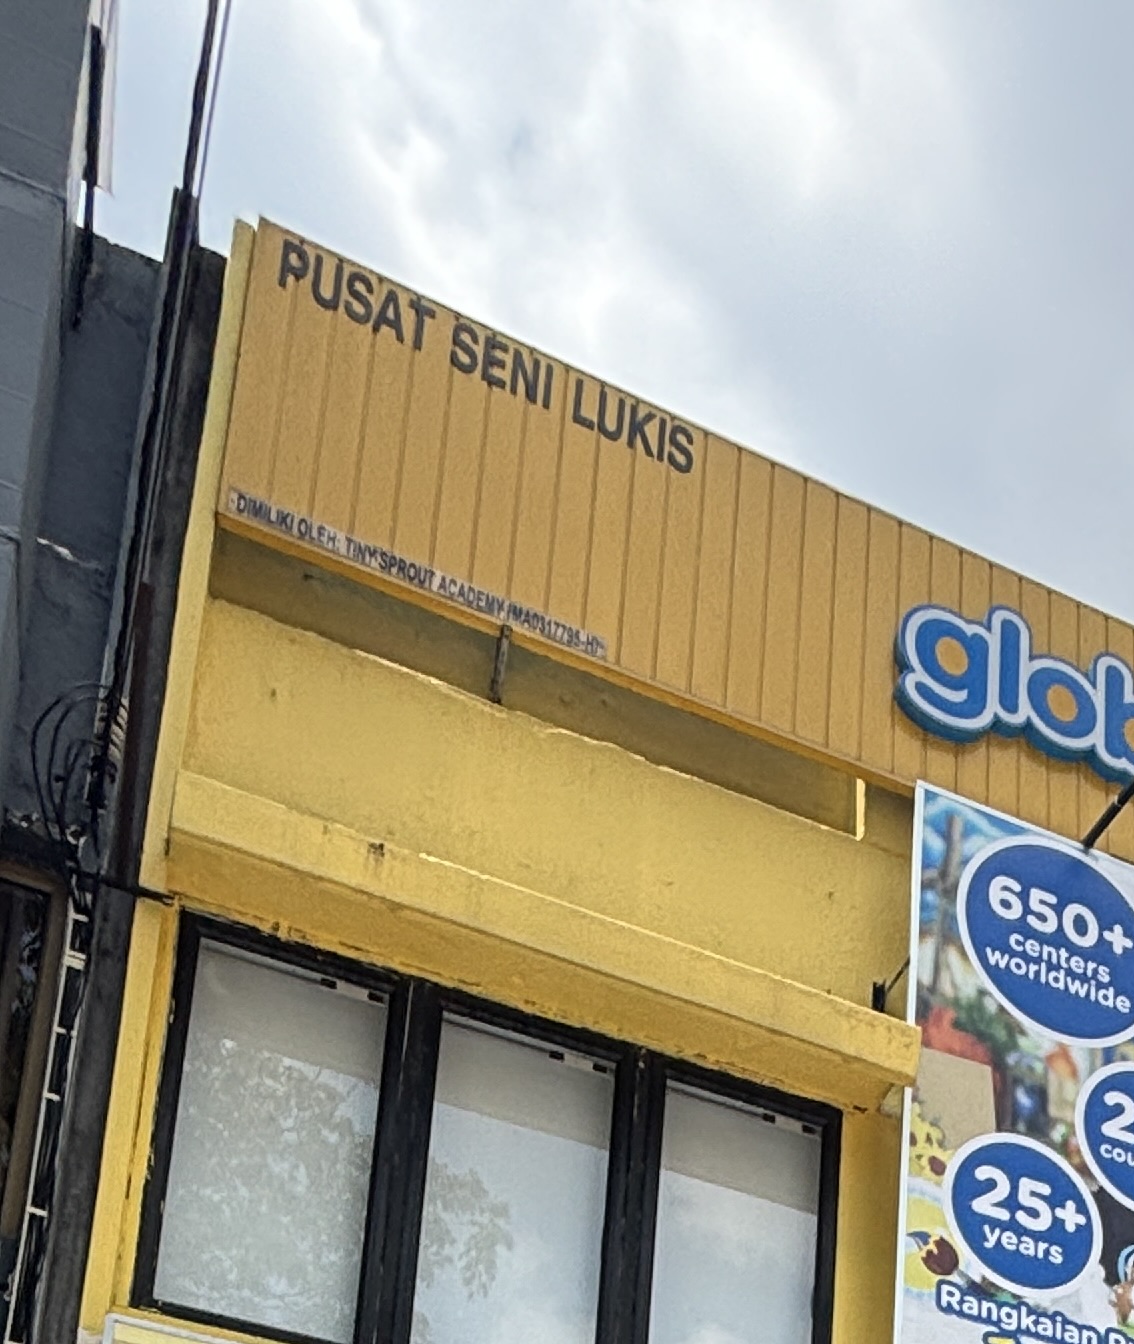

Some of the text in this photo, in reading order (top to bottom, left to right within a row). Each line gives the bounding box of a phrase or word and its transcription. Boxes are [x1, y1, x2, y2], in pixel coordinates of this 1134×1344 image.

[278, 239, 694, 473] PUSAT SENI LUKIS
[237, 493, 295, 532] DIMILIKI
[437, 576, 505, 615] ACADEMY
[987, 873, 1134, 957] 650+
[984, 946, 1132, 1015] worldwide
[1008, 930, 1112, 985] centers
[970, 1164, 1086, 1234] 25+
[983, 1222, 1064, 1264] years
